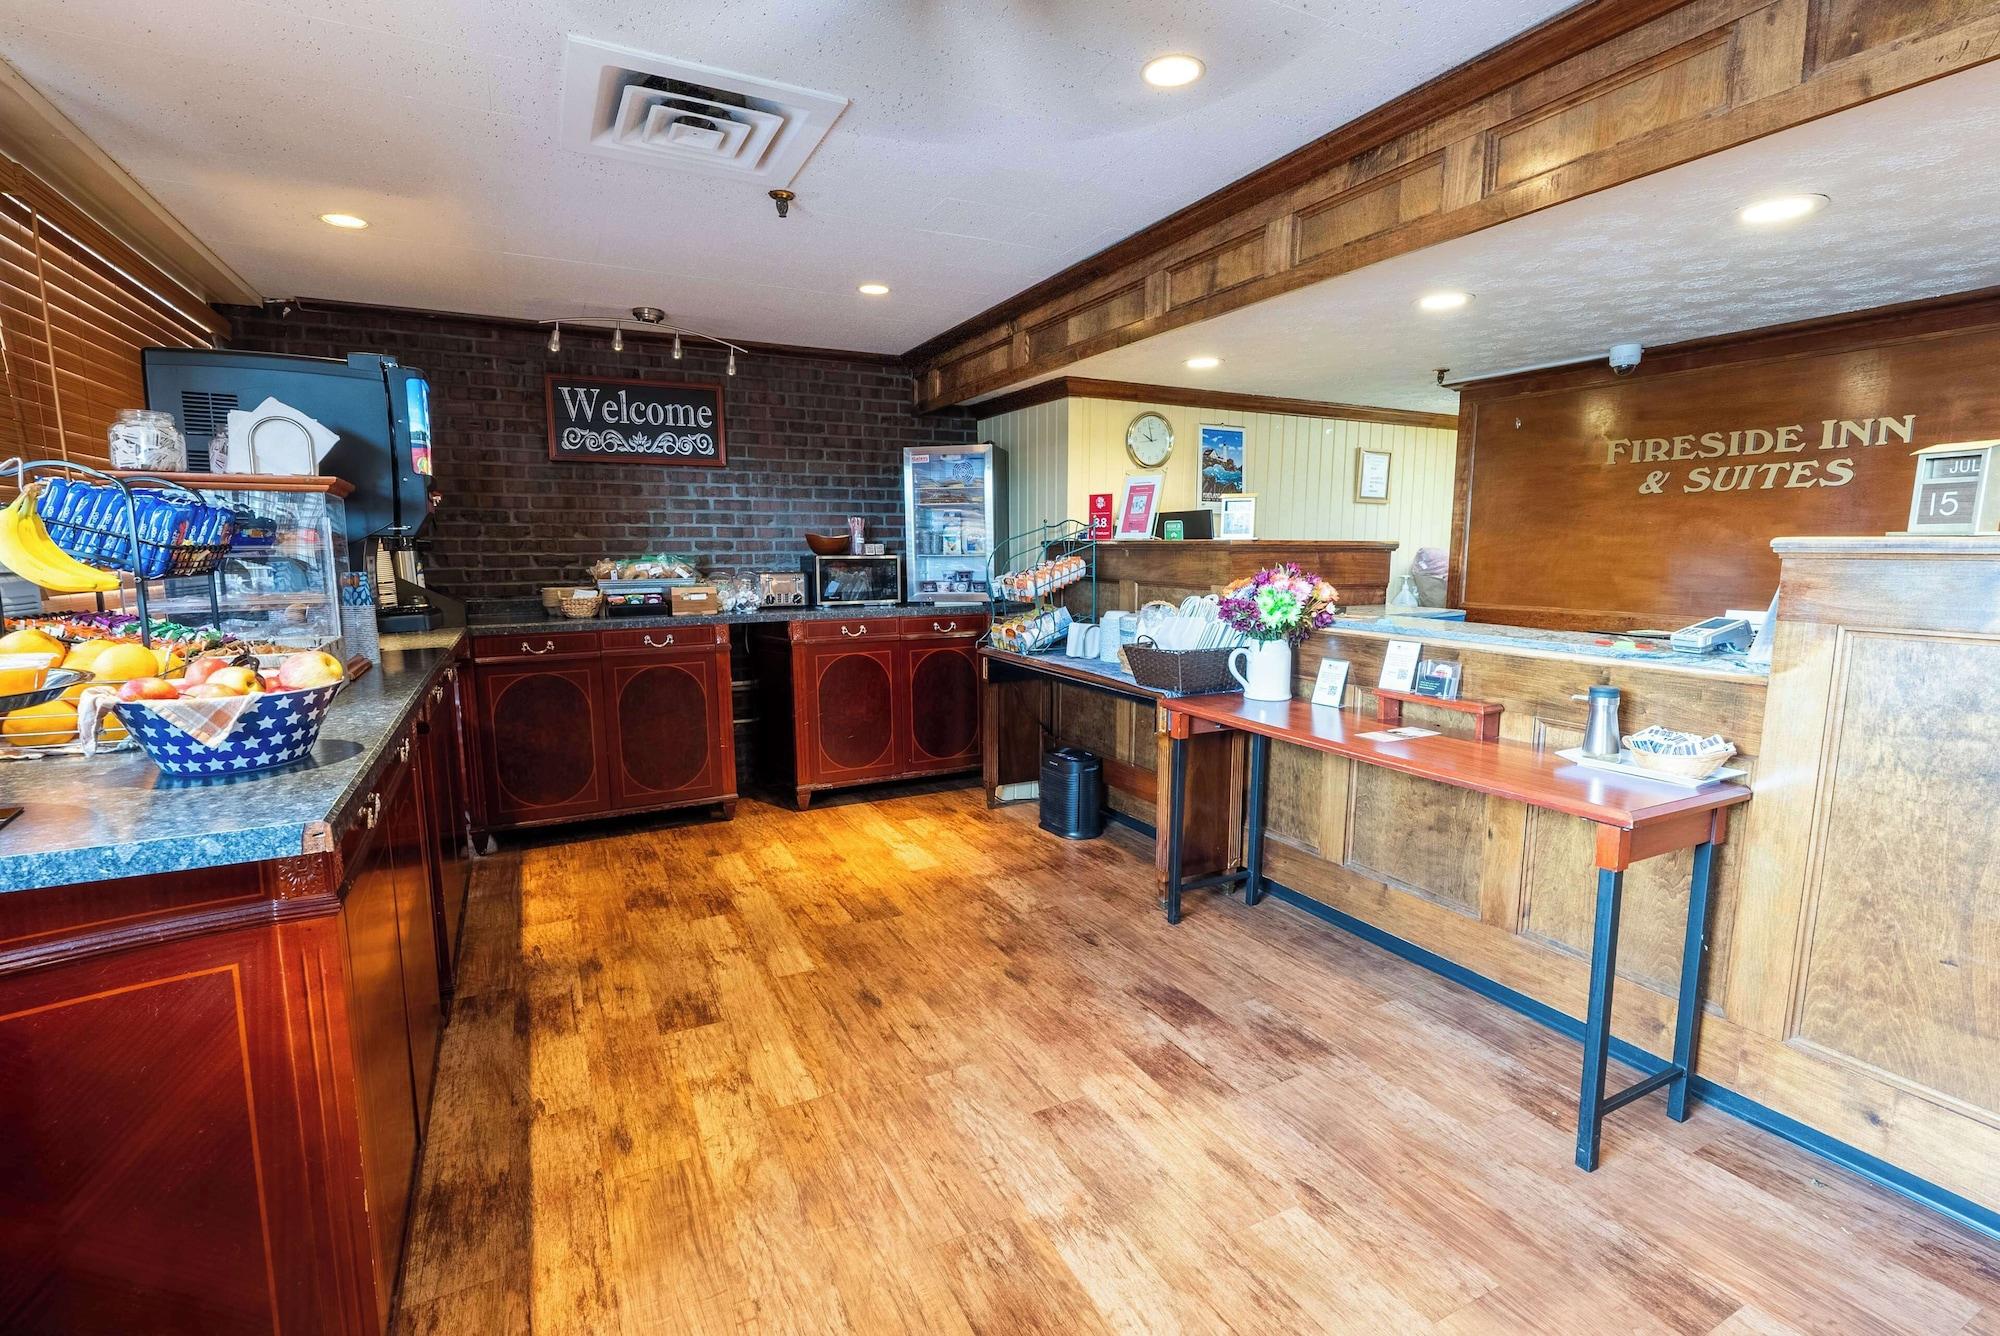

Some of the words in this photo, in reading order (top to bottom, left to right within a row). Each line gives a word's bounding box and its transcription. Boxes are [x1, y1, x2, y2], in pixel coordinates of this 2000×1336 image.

[558, 387, 713, 429] Welcome
[1606, 424, 1805, 465] FIRESIDE
[1818, 414, 1916, 450] INN
[1638, 469, 1671, 494] &
[1683, 457, 1855, 494] SUITES
[1949, 458, 1981, 474] JUL
[1929, 491, 1959, 516] 15
